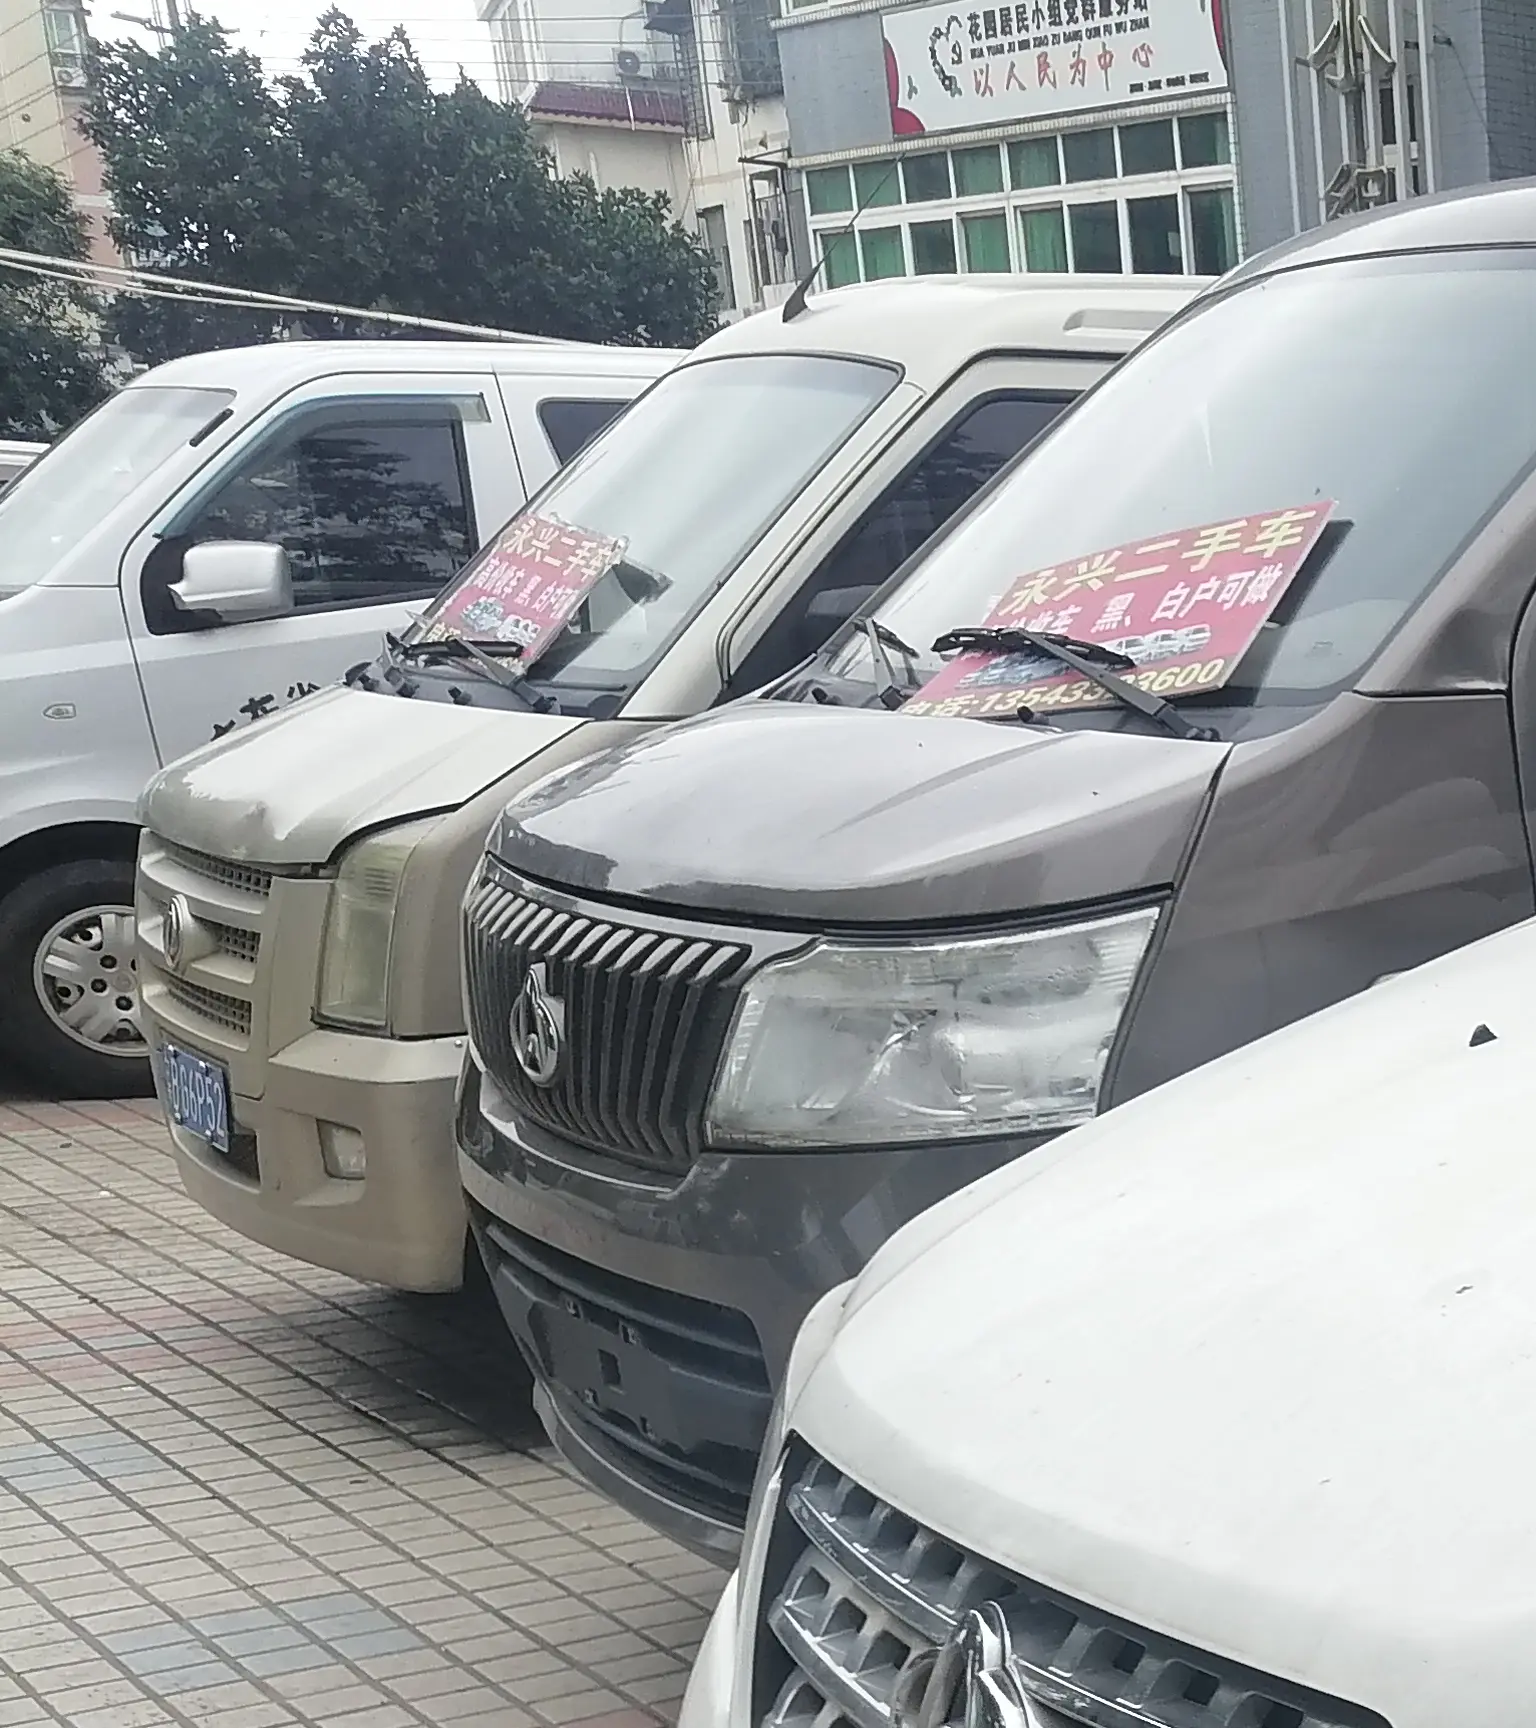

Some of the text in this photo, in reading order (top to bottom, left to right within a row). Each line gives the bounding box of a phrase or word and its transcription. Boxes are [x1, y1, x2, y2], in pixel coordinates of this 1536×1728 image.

[973, 42, 1154, 98] 以人民为中心
[502, 518, 614, 582] 永兴二手车
[998, 509, 1317, 616] 永兴二手车
